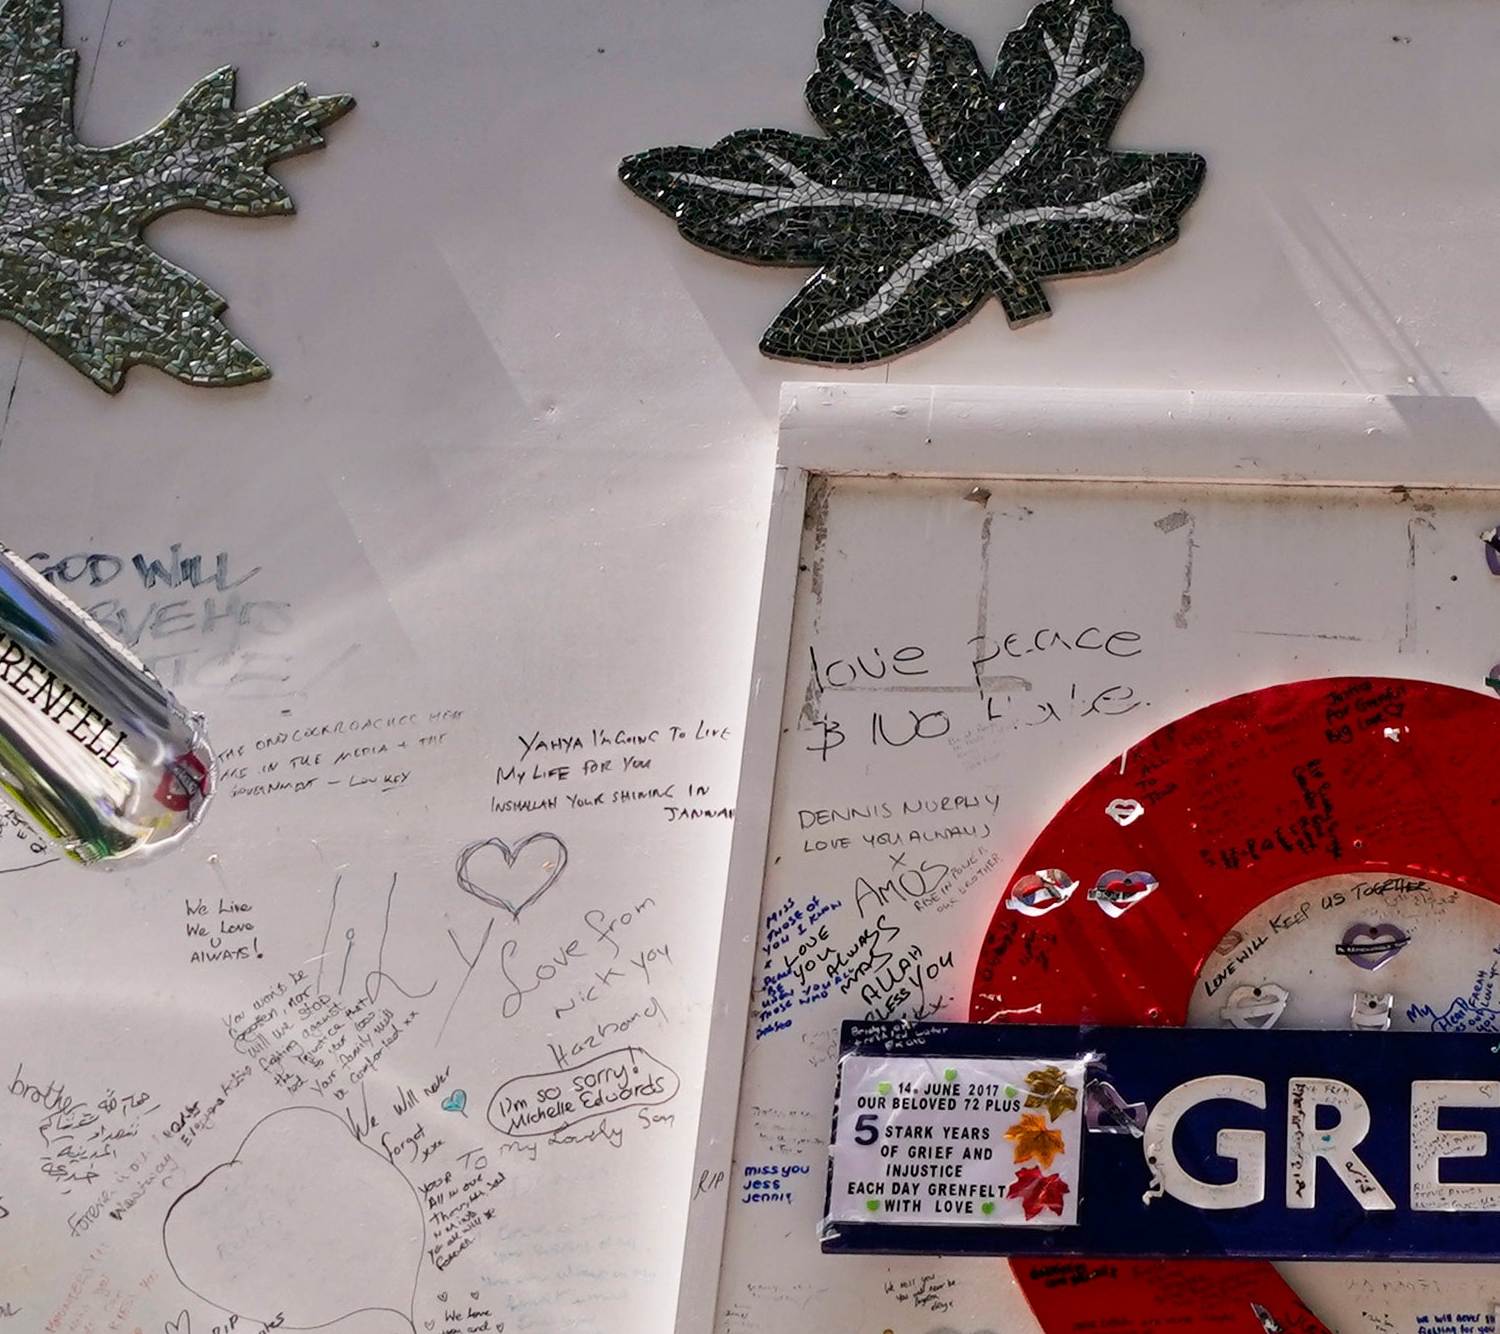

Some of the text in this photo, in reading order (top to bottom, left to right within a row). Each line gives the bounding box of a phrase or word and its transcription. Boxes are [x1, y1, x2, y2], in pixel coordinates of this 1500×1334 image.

[924, 1084, 960, 1096] JUNE
[969, 1085, 999, 1096] 2017
[858, 1097, 1020, 1112] OUR BELOVED 72 PLUS
[854, 1114, 989, 1145] 5 STARK YEARS
[881, 1146, 992, 1160] OF GRIEF AND
[887, 1165, 962, 1177] INJUSTICE
[848, 1183, 1006, 1198] EACH DAY GRENFELT
[885, 1200, 973, 1213] WITH LOVE
